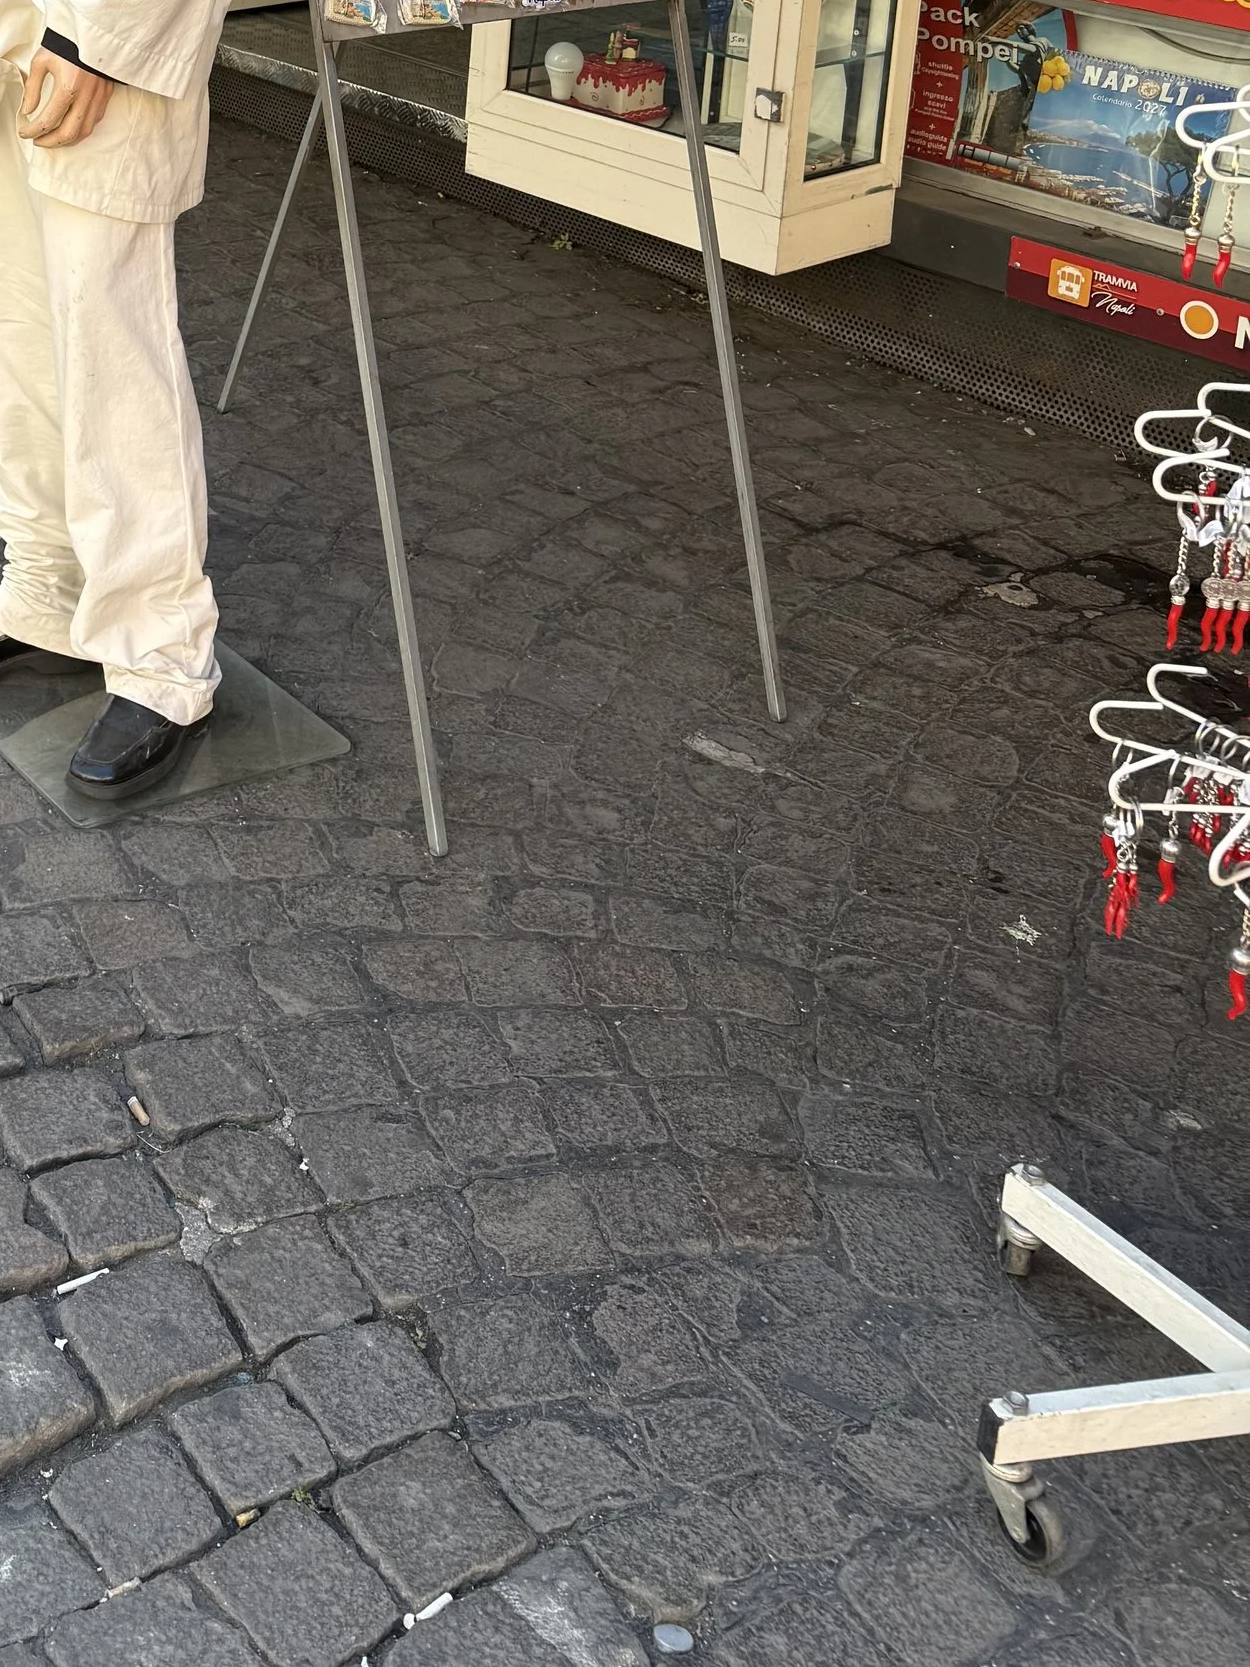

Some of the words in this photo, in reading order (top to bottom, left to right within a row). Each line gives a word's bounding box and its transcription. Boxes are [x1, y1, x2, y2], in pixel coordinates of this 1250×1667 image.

[928, 61, 953, 72] shuttle
[922, 89, 954, 103] ingresso
[1092, 94, 1133, 108] Calendario
[927, 98, 947, 110] scavi
[927, 140, 947, 152] guide
[1093, 270, 1139, 292] TRAMVIA
[1091, 291, 1136, 316] Napoli
